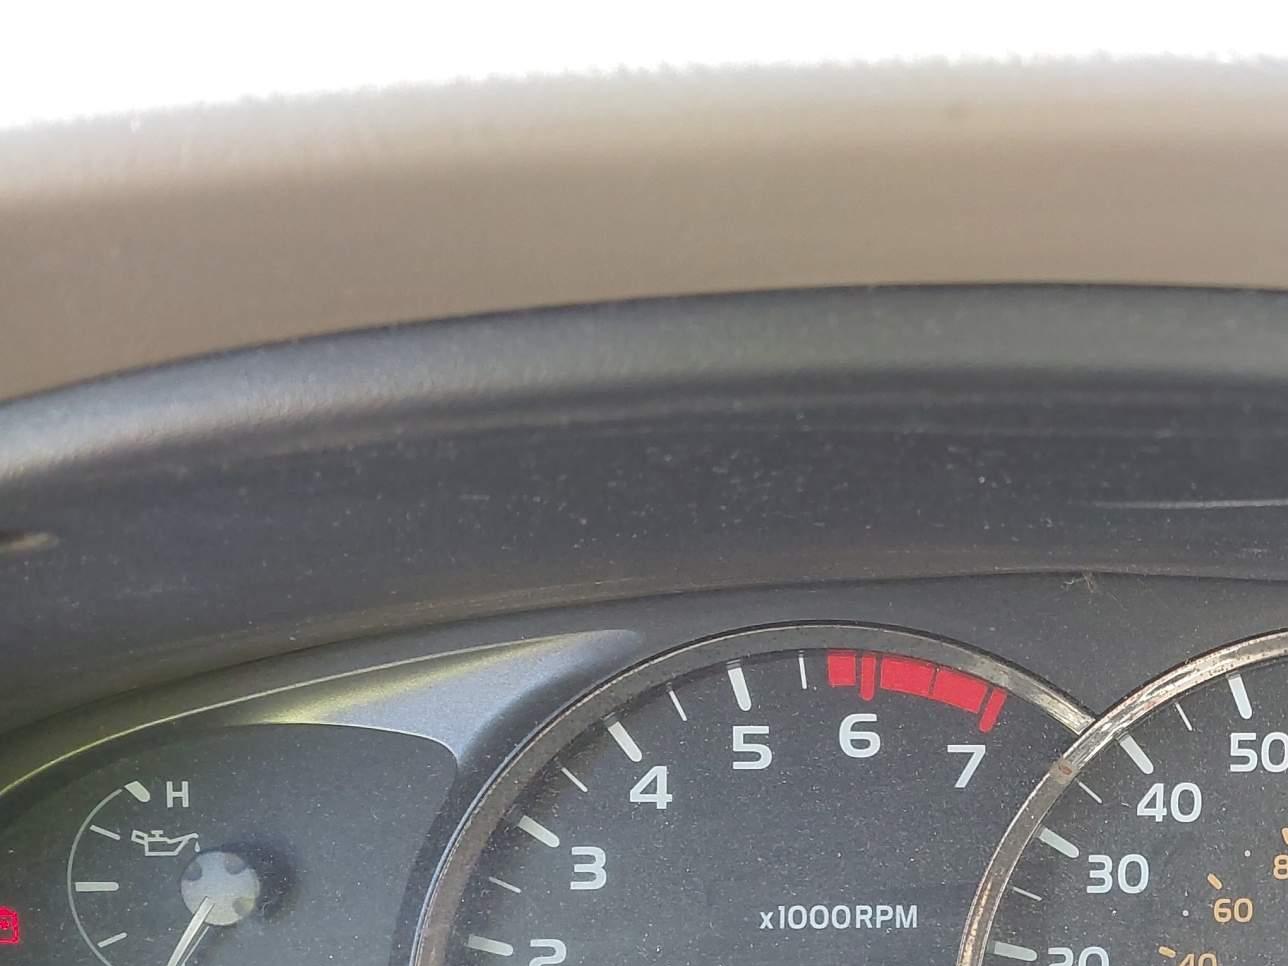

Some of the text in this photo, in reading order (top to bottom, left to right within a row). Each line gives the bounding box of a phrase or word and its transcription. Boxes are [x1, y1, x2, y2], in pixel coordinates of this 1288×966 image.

[732, 726, 773, 769] 5
[838, 714, 881, 757] 6
[629, 766, 673, 809] 4
[946, 744, 986, 788] 7
[166, 781, 189, 807] H
[1137, 783, 1202, 823] 40
[569, 846, 607, 890] 3
[1086, 854, 1149, 893] 30
[1213, 899, 1253, 924] 60
